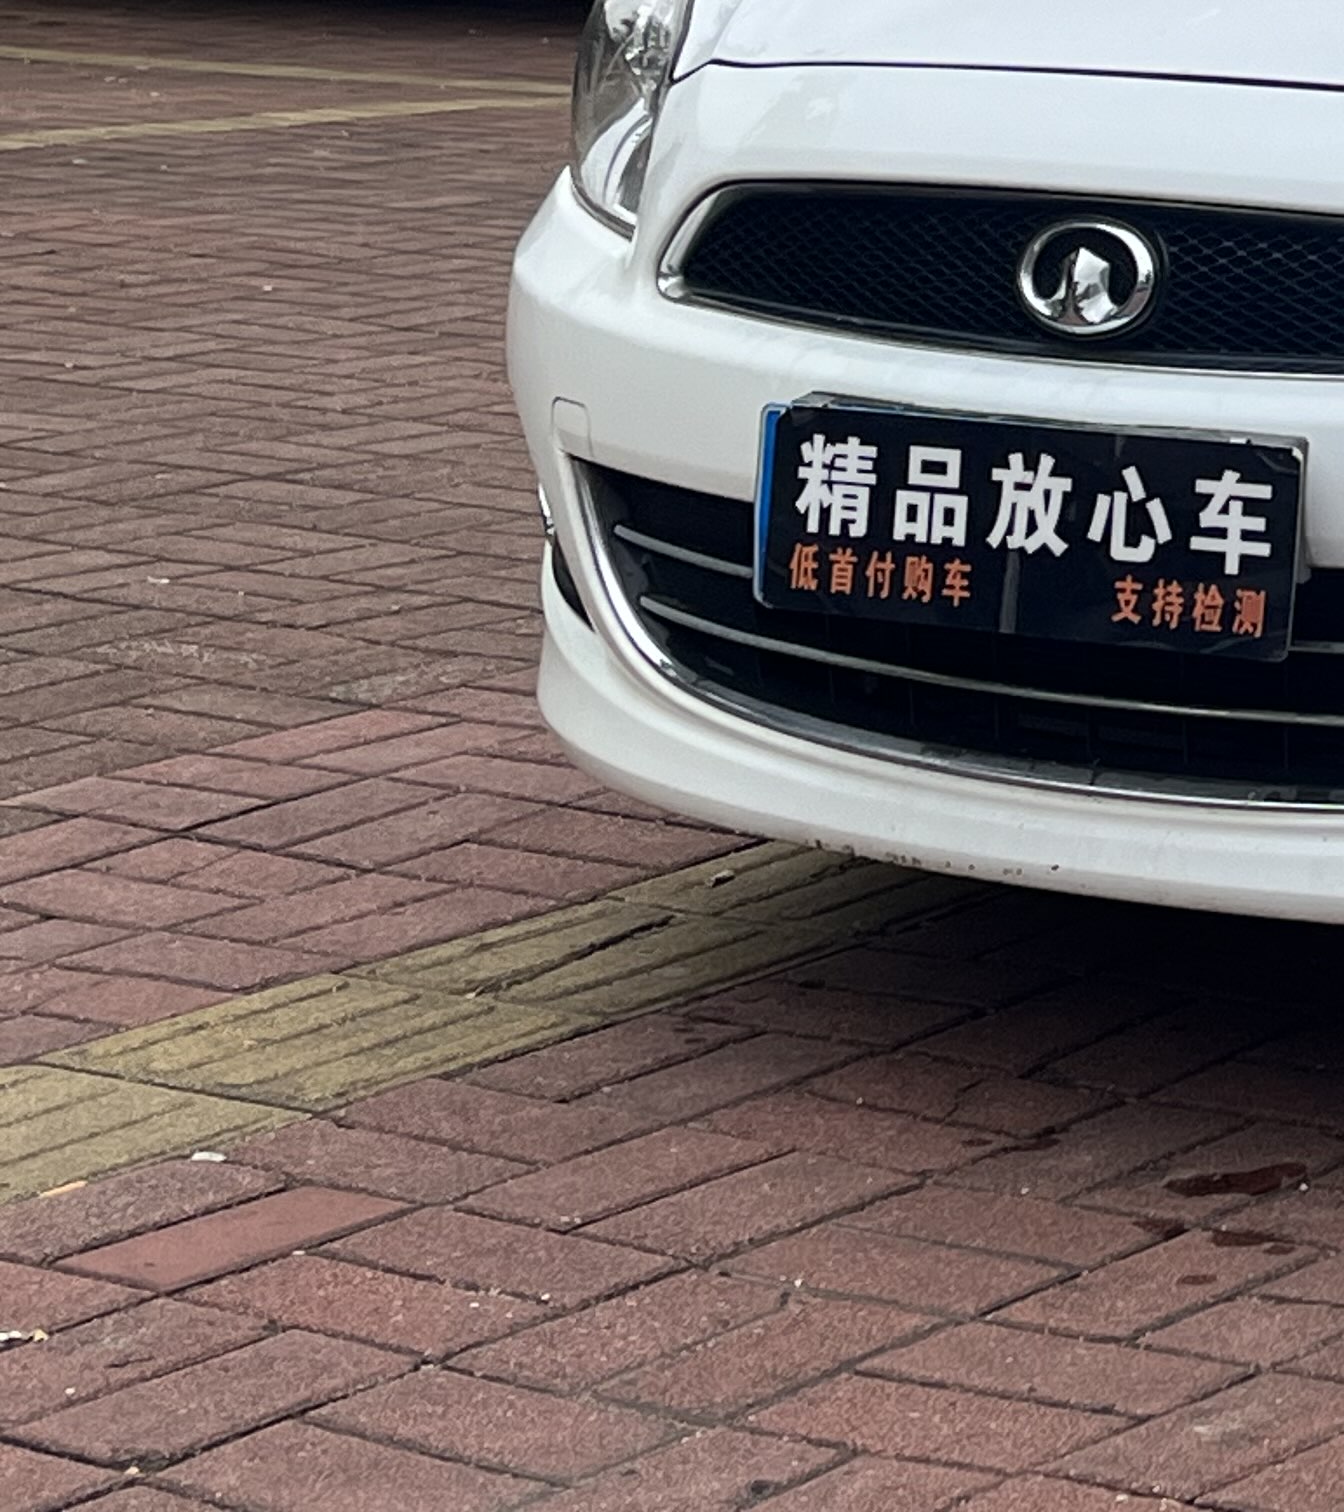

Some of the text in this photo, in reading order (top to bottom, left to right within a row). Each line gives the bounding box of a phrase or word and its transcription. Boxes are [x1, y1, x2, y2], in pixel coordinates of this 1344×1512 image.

[796, 433, 1273, 576] 精品放心车
[788, 542, 972, 608] 低首付购车
[1110, 574, 1267, 639] 支持检测
